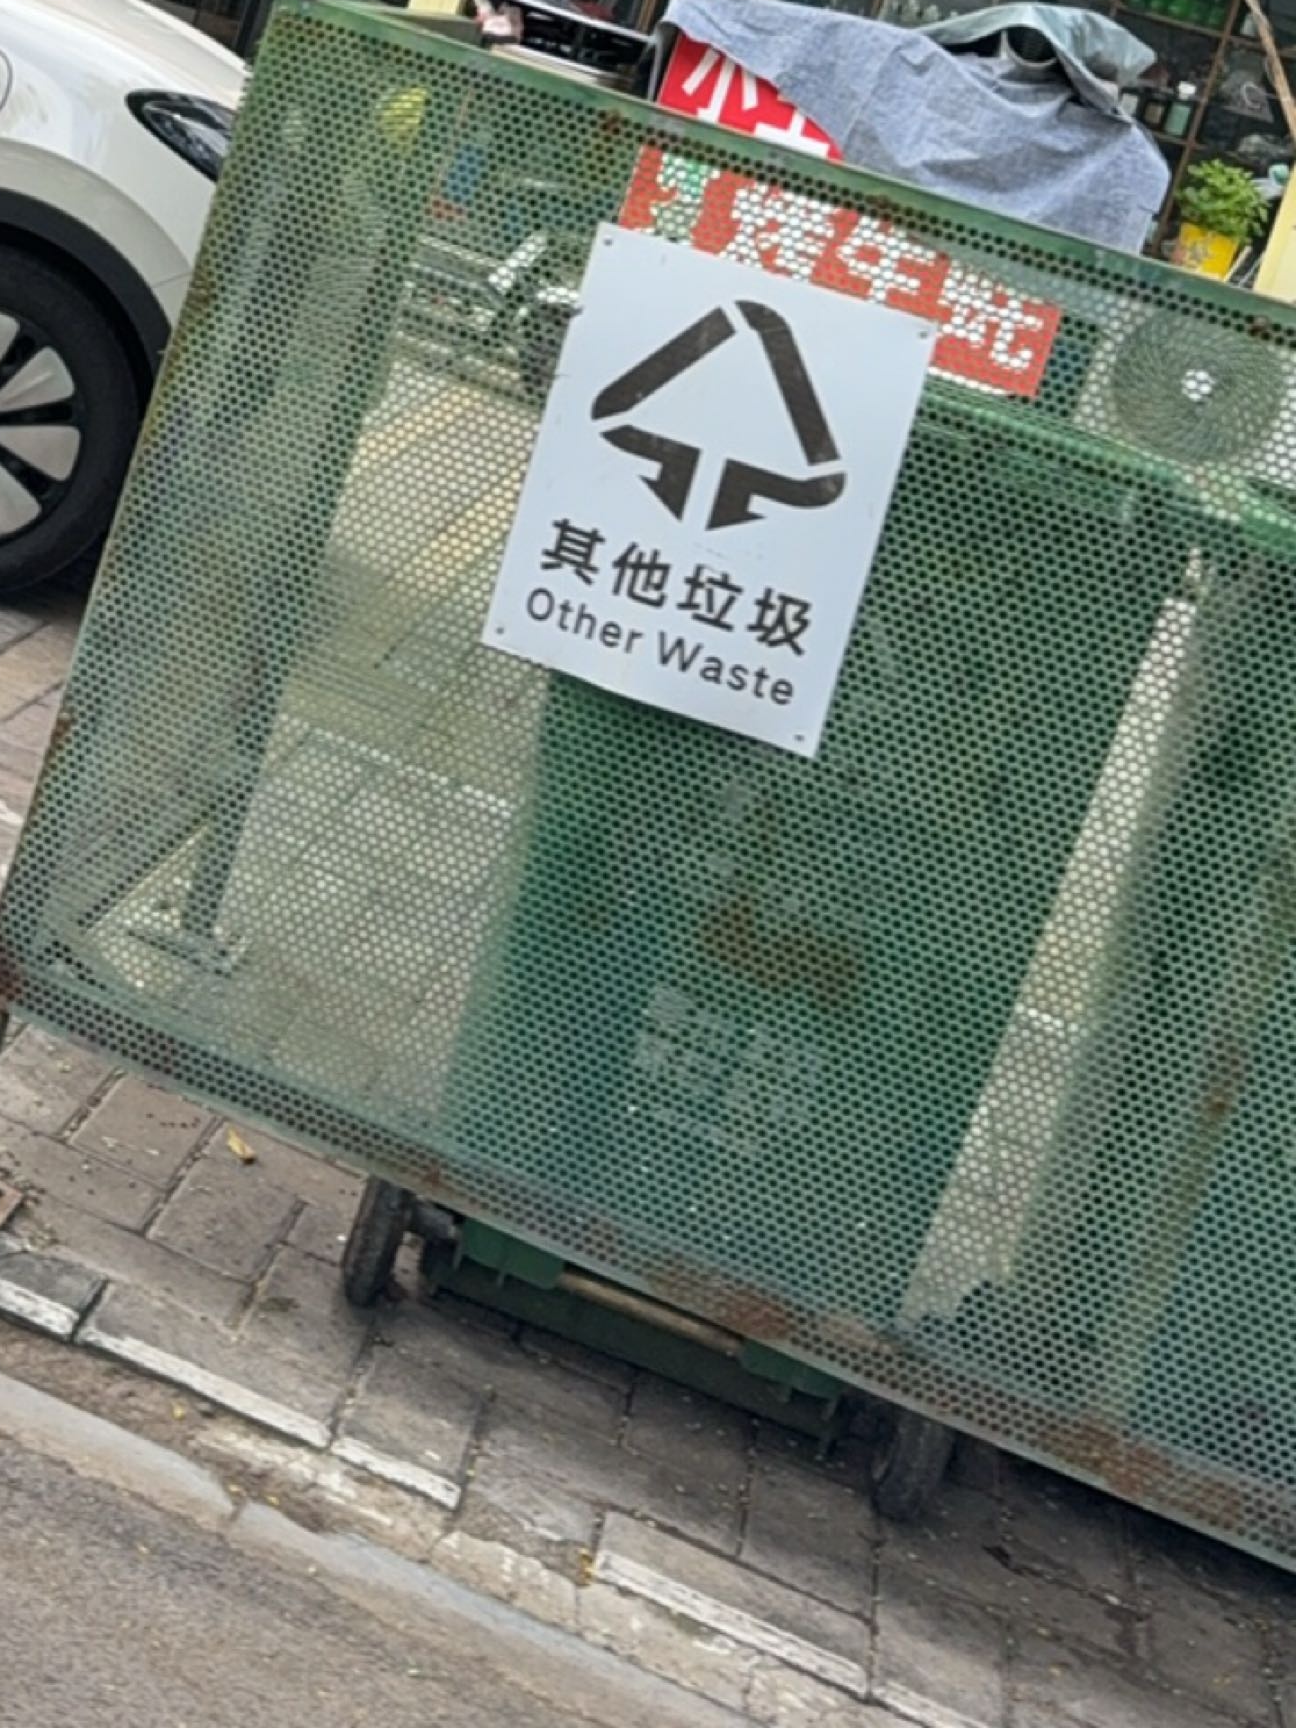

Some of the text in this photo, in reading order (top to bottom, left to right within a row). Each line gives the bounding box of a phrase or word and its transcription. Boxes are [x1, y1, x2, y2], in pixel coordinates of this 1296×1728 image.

[525, 587, 795, 706] Other Waste
[540, 518, 813, 656] 其他垃圾
